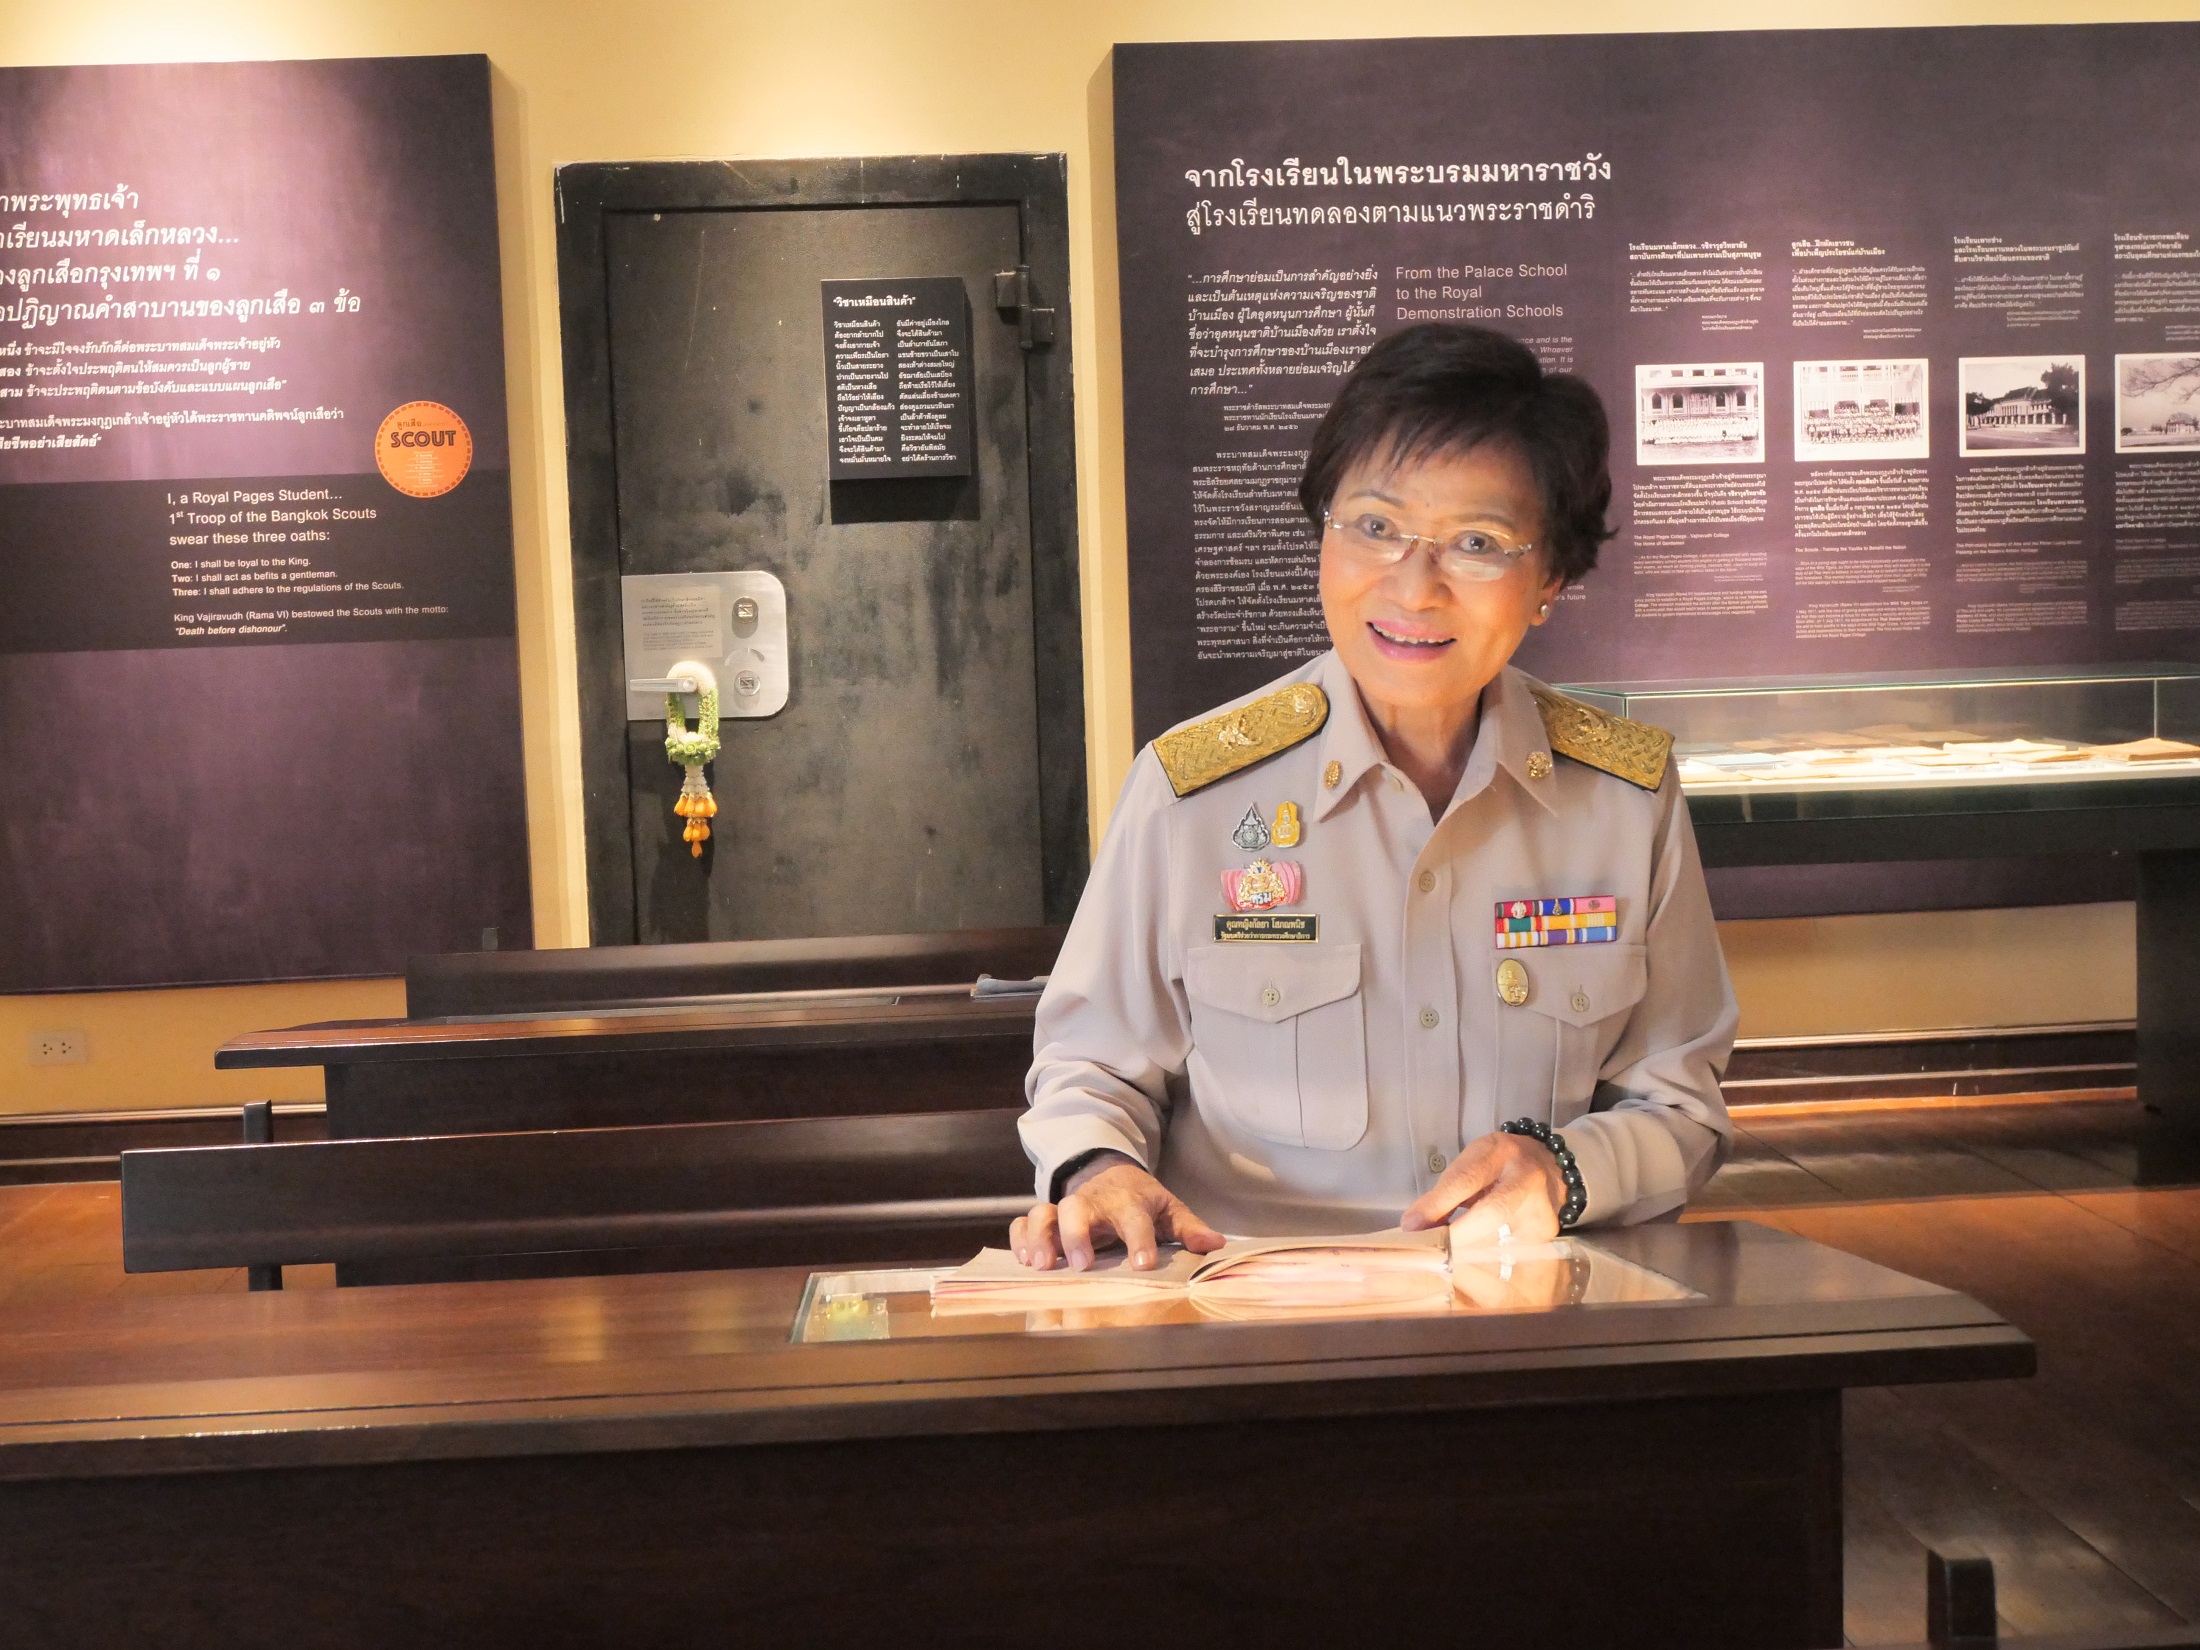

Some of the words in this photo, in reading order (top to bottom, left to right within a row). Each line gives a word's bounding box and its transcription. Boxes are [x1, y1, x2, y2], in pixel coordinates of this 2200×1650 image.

[1185, 153, 1611, 187] จากโรงเรียนในพระบรมมหาราชวัง
[1187, 193, 1595, 235] สู่โรงเรียนทดลองตามแนวพระราชดำริ
[183, 249, 201, 281] ที่
[206, 266, 221, 282] ๑
[1396, 267, 1432, 280] From
[1437, 266, 1459, 279] the
[1465, 265, 1513, 278] Palace
[1519, 264, 1567, 277] School
[308, 300, 325, 313] ๓
[334, 289, 361, 313] ข้อ
[1396, 287, 1409, 300] to
[1415, 287, 1437, 299] the
[1442, 285, 1482, 301] Royal
[1189, 308, 1234, 321] บ้านเมือง
[1397, 306, 1501, 320] Demonstration
[1507, 304, 1564, 317] Schools
[1190, 367, 1214, 376] เสมอ
[391, 430, 456, 448] SCOUT
[167, 493, 176, 505] I,
[180, 495, 188, 504] a
[193, 492, 229, 506] Royal
[234, 491, 274, 505] Pages
[278, 489, 342, 501] Student...
[188, 512, 226, 526] Troop
[229, 511, 243, 523] of
[247, 511, 267, 522] the
[272, 508, 328, 523] Bangkok
[333, 507, 377, 520] Scouts
[169, 535, 209, 546] swear
[212, 532, 248, 544] these
[253, 531, 286, 543] three
[290, 530, 330, 541] oaths:
[171, 561, 192, 569] One:
[200, 560, 221, 568] shall
[224, 559, 235, 568] be
[238, 559, 258, 568] loyal
[272, 558, 285, 566] the
[289, 557, 311, 567] King.
[172, 574, 193, 583] Two:
[201, 573, 222, 582] shall
[225, 573, 239, 581] act
[254, 571, 279, 580] befits
[290, 570, 338, 580] gentleman.
[173, 587, 201, 596] Three:
[209, 586, 230, 595] shall
[232, 585, 263, 594] adhere
[265, 585, 274, 593] to
[277, 584, 290, 592] the
[293, 583, 342, 593] regulations
[355, 582, 369, 590] the
[371, 581, 404, 589] Scouts.
[174, 613, 194, 623] King
[197, 612, 243, 622] Vajiravudh
[246, 611, 274, 621] (Rama
[276, 610, 289, 620] VI)
[291, 608, 334, 618] bestowed
[336, 608, 351, 616] the
[353, 607, 383, 615] Scouts
[385, 607, 403, 615] with
[405, 606, 419, 614] the
[422, 606, 448, 614] motto:
[208, 626, 236, 634] before
